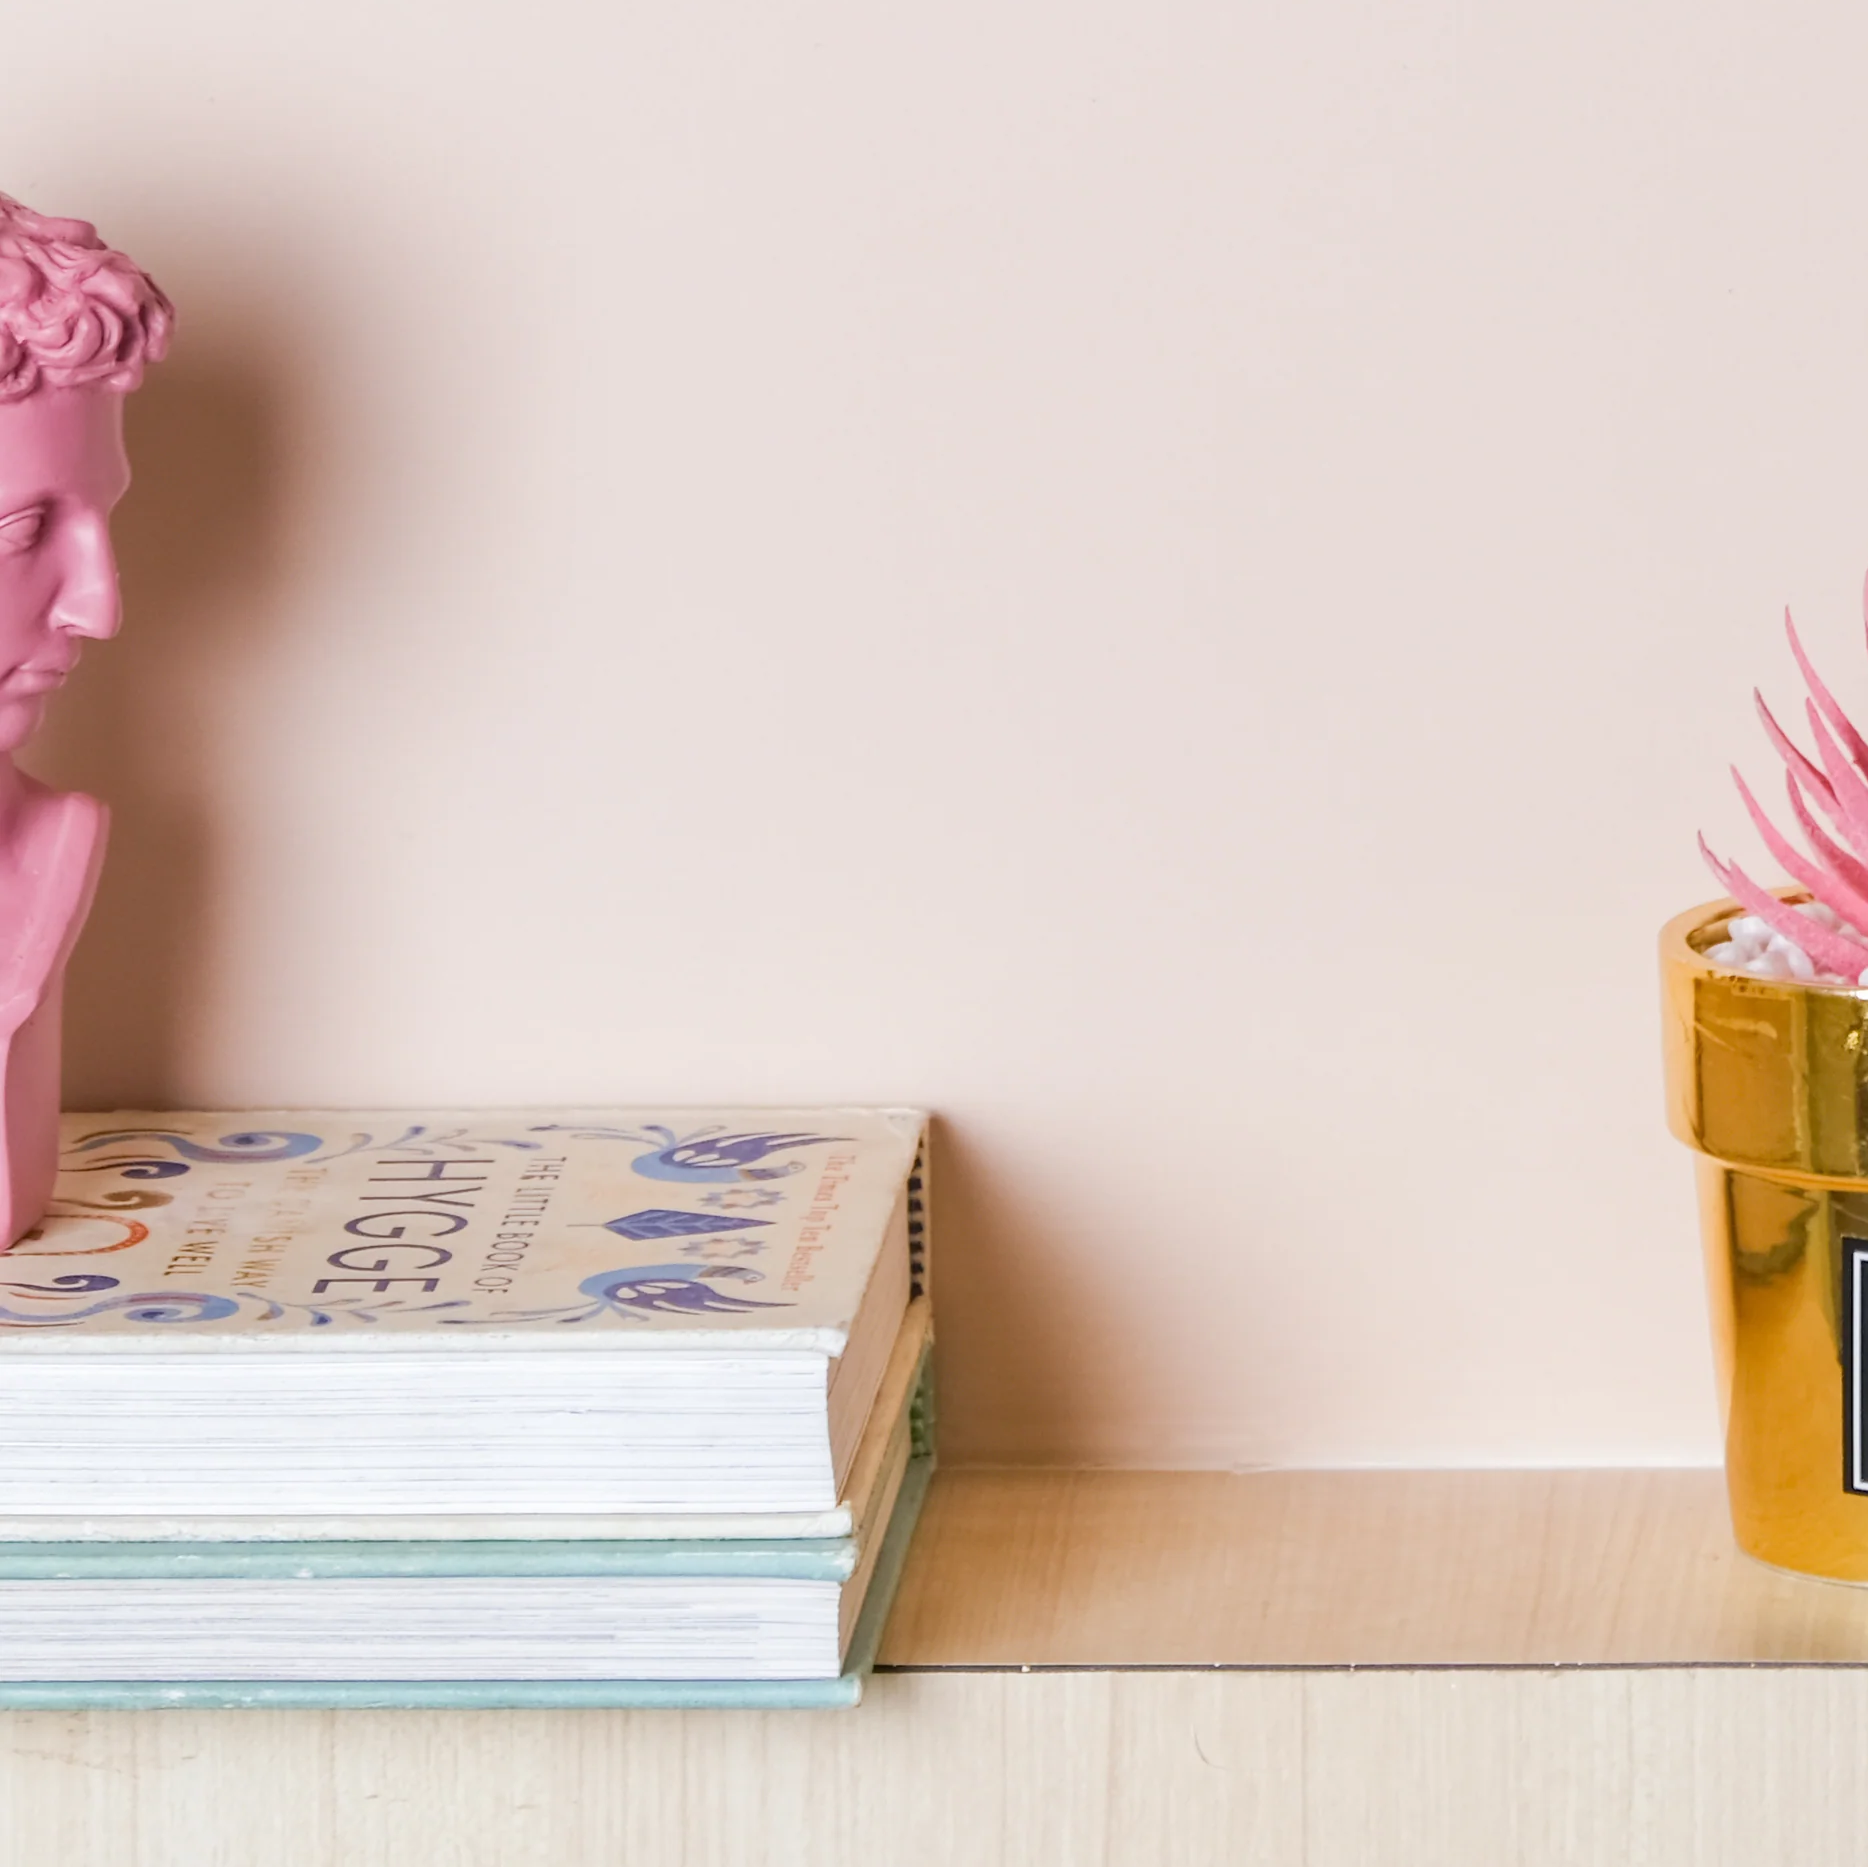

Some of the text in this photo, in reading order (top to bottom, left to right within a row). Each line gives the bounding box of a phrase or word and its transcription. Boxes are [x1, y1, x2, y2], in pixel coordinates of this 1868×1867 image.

[163, 1182, 251, 1277] TO LVE WELL
[230, 1258, 282, 1288] WAY
[311, 1159, 496, 1294] HYGGE
[471, 1156, 567, 1294] THE LITTLE BOOK OF
[780, 1154, 856, 1291] The Times Top Ten Bestseller
